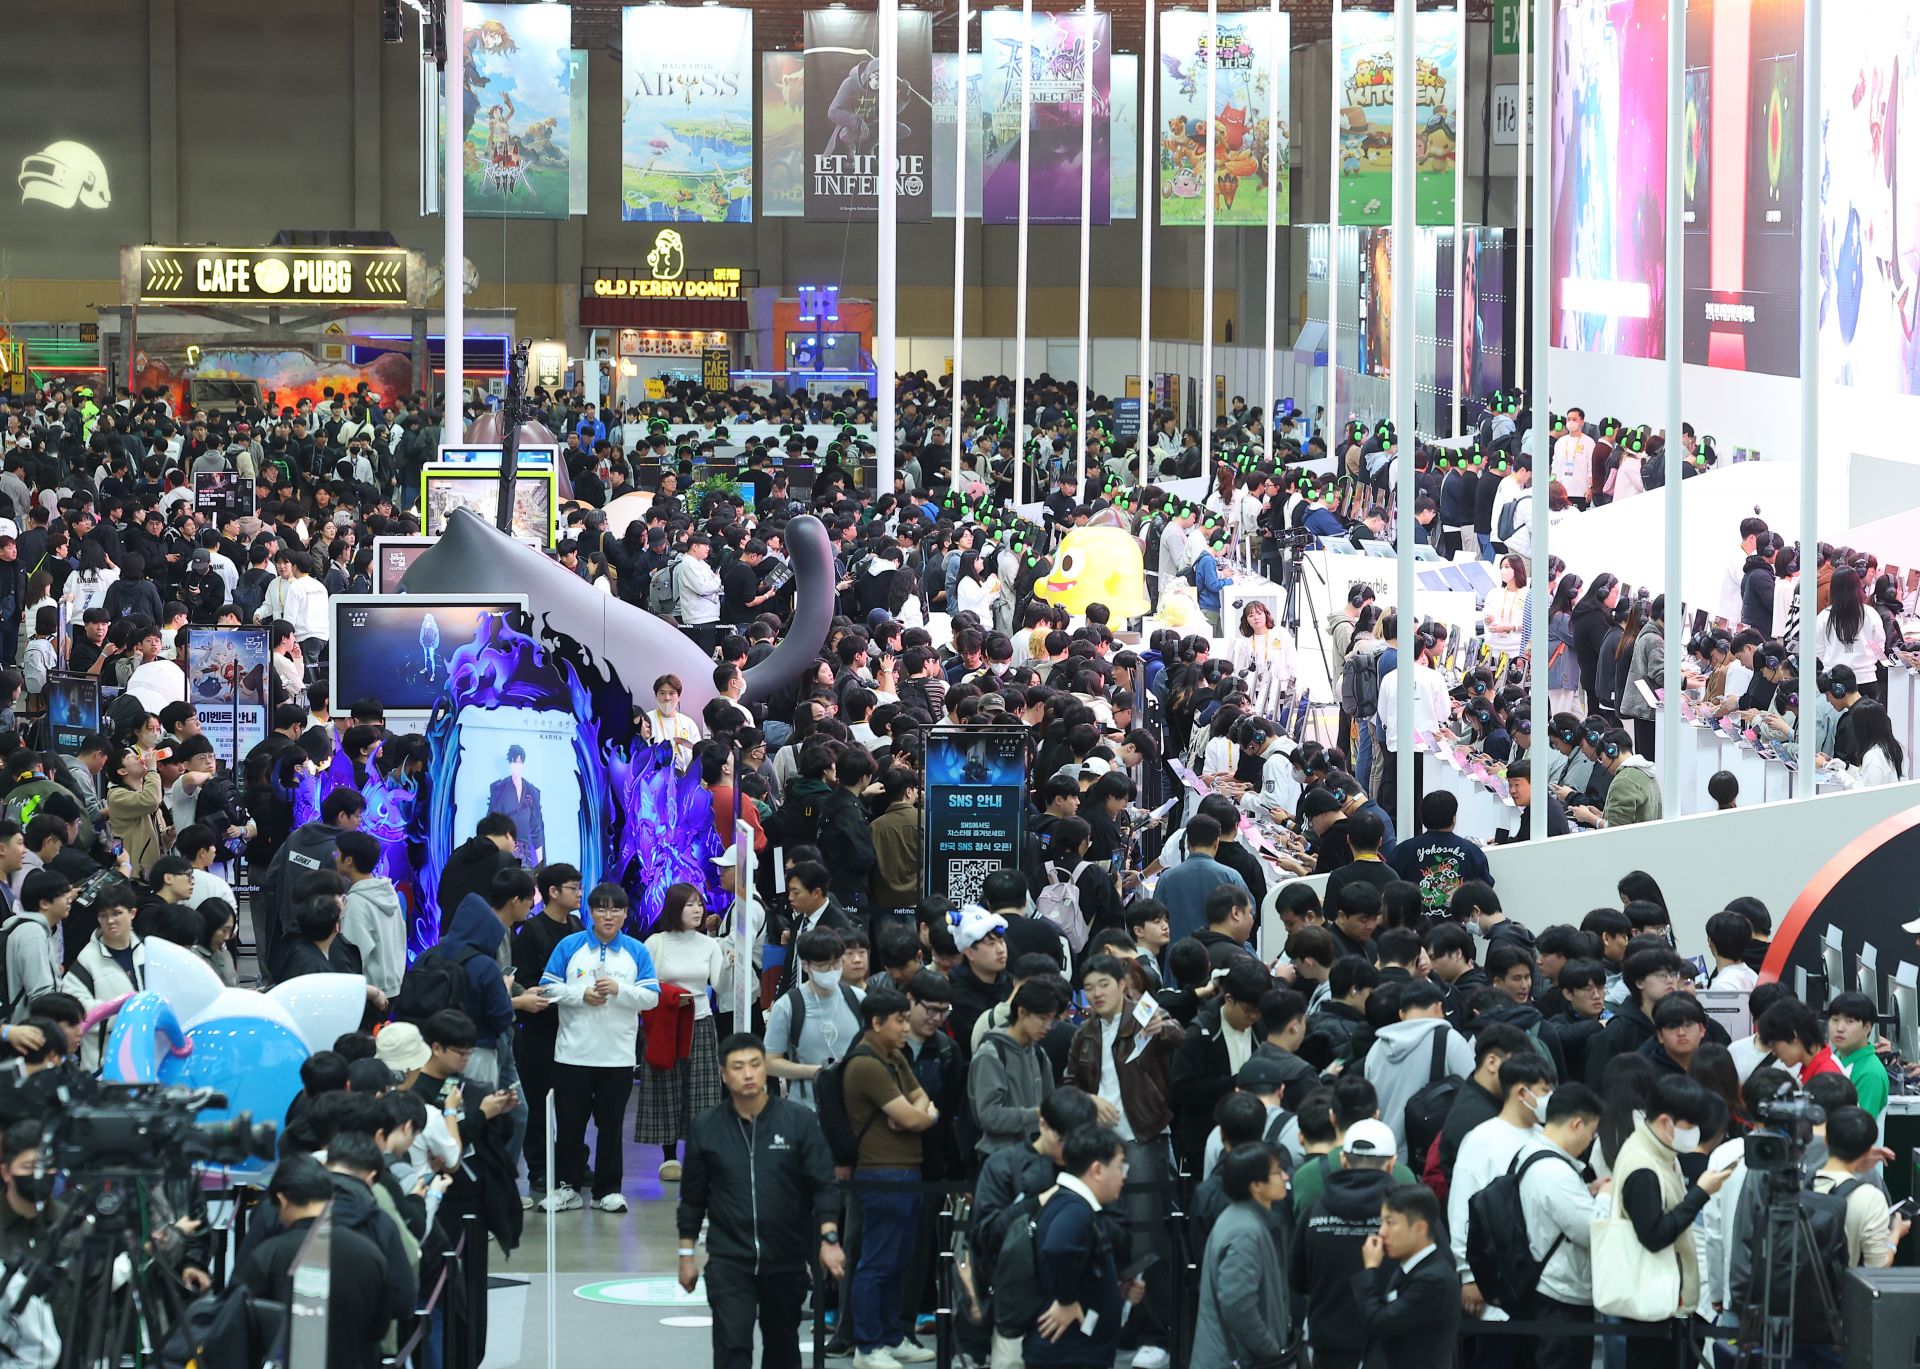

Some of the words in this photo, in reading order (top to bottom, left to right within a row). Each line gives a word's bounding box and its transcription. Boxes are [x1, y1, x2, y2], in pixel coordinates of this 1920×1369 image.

[634, 70, 740, 103] ABYSS
[1346, 85, 1446, 106] KITCEN
[814, 154, 848, 174] LET
[853, 154, 877, 174] IT
[896, 155, 924, 175] IE
[814, 175, 924, 196] INFENO
[196, 258, 250, 292] CAFE
[293, 259, 352, 293] PUBG
[594, 279, 628, 295] OLD
[629, 280, 684, 296] FERRY
[685, 281, 740, 298] DONUT
[704, 361, 728, 376] CAFE
[704, 376, 728, 391] PUBG
[198, 711, 233, 724] 이벤트
[948, 794, 973, 808] SNS
[976, 794, 1003, 808] 안내
[939, 842, 956, 851] 한국
[957, 842, 973, 851] SNS
[1416, 843, 1466, 862] Yokosuka
[894, 907, 915, 915] netma
